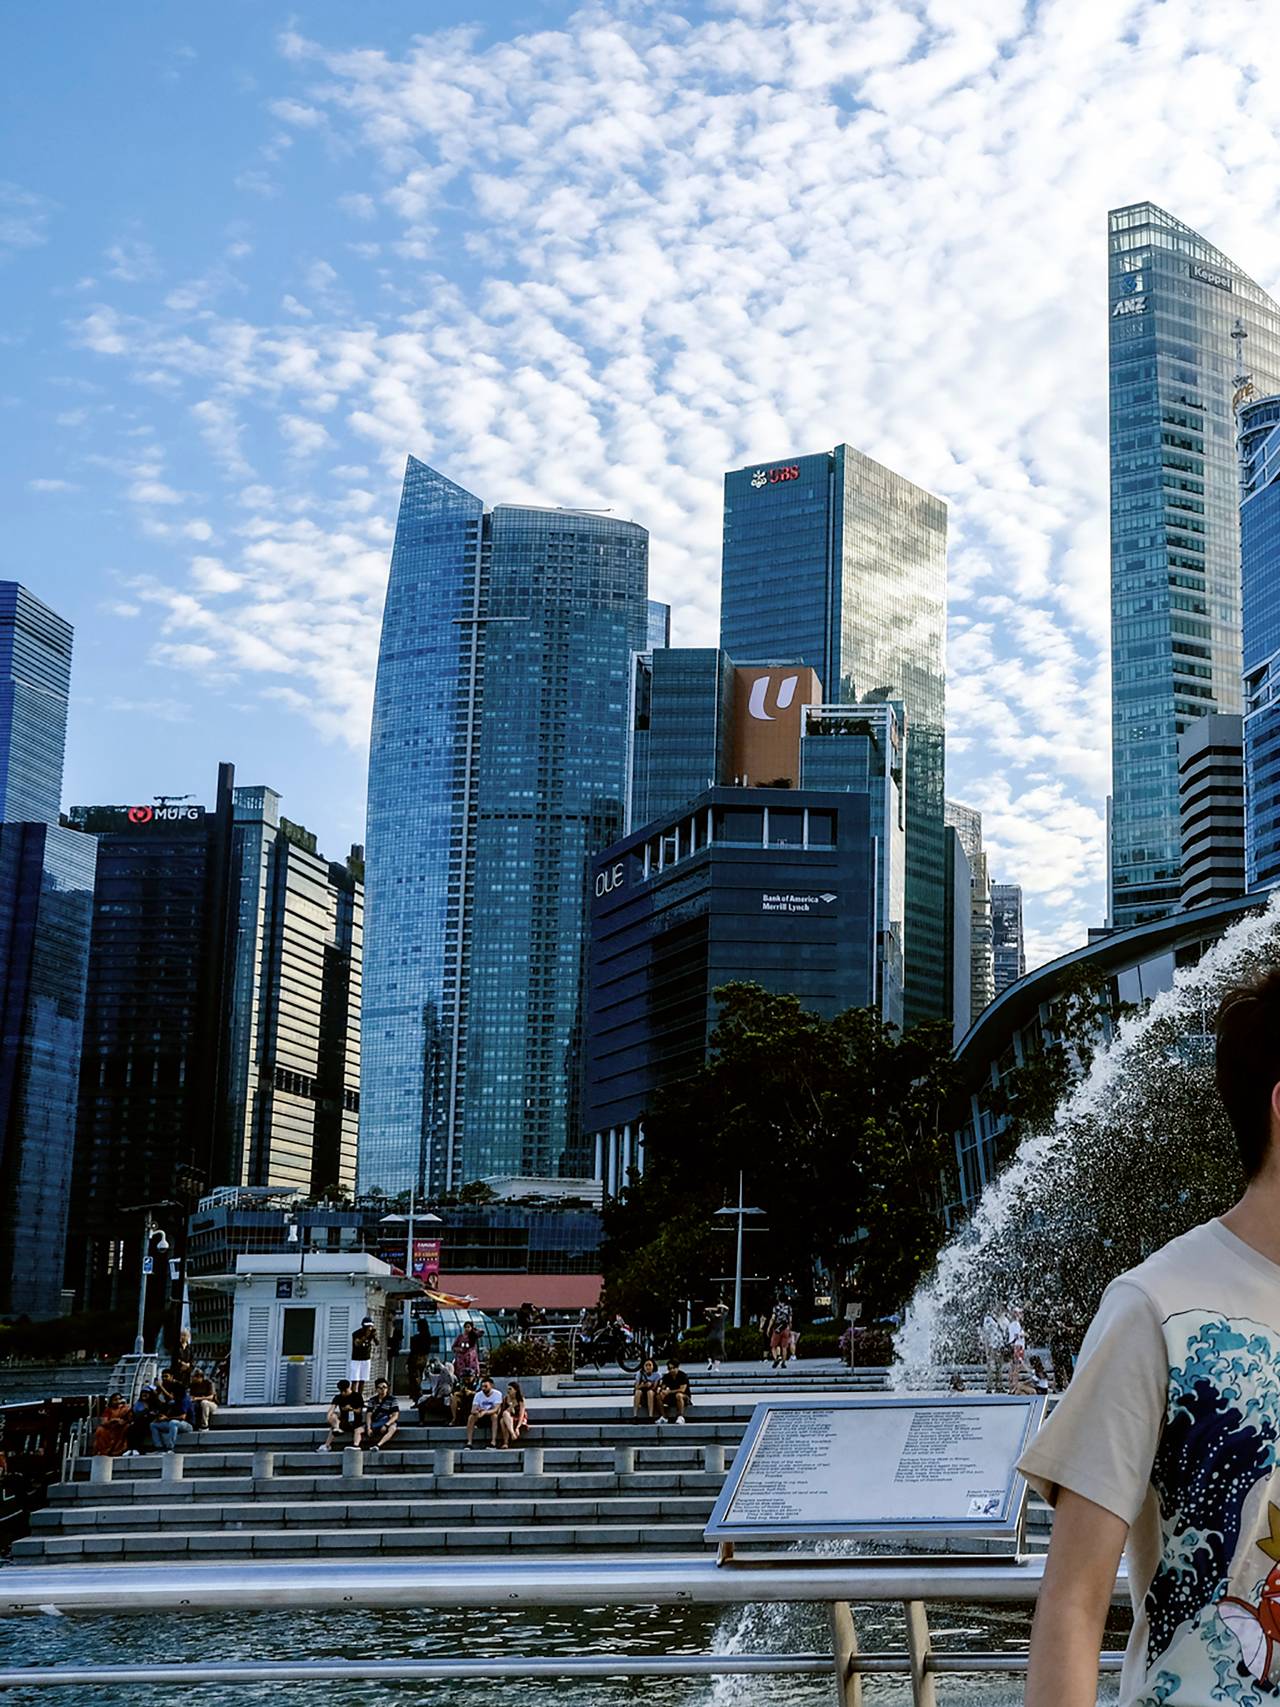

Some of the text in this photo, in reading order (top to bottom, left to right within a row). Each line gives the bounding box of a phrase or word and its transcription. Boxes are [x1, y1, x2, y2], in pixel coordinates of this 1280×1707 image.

[1194, 265, 1231, 289] Keppel
[1112, 296, 1148, 317] ANZ
[769, 464, 799, 483] UBS
[154, 807, 199, 820] MUFG
[595, 862, 624, 898] OUE
[762, 894, 780, 902] Bank
[790, 895, 819, 903] America
[762, 902, 810, 912] Merrill Lynch
